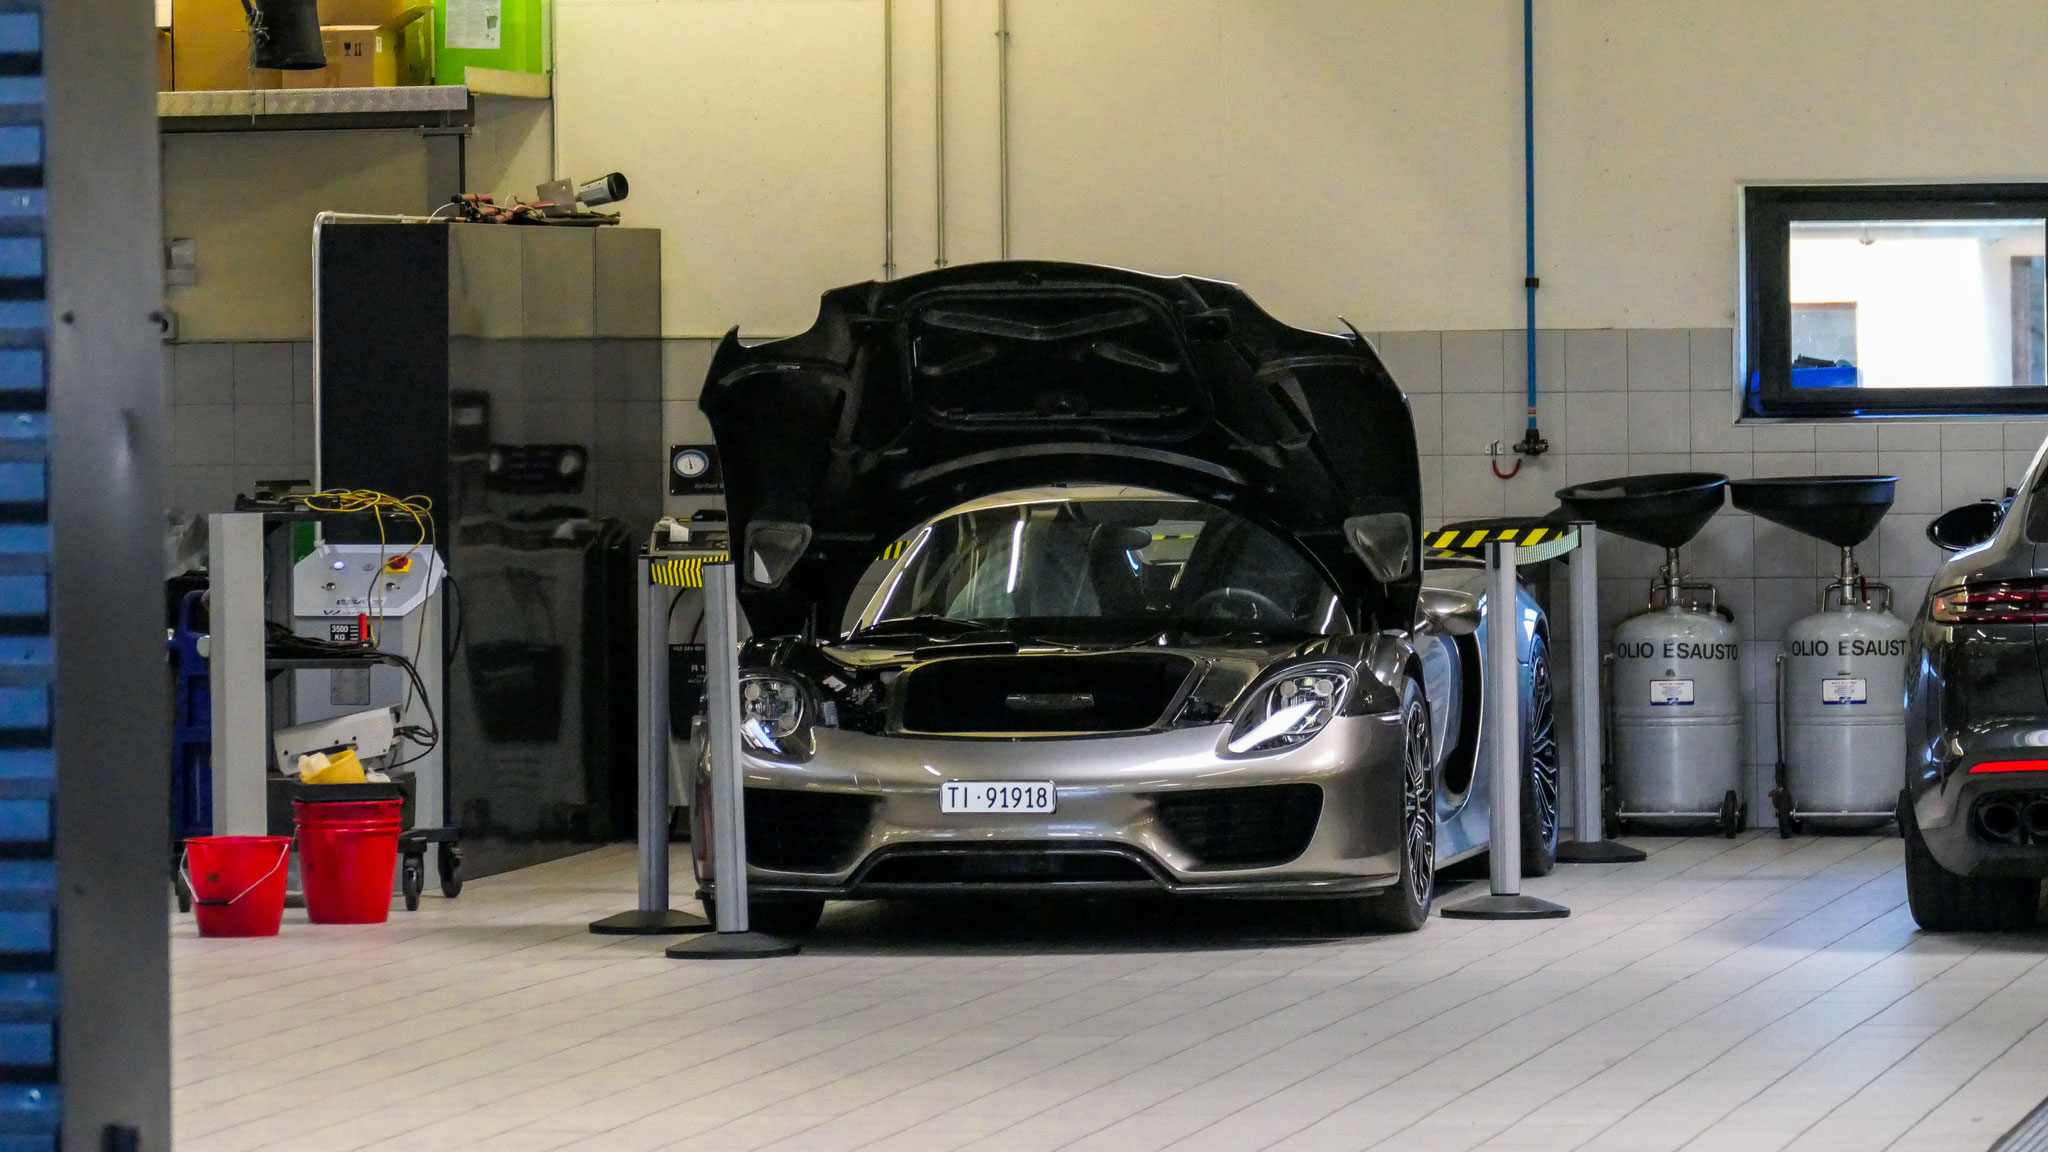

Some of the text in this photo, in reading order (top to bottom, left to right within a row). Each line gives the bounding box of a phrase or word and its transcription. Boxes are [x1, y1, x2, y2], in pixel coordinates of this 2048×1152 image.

[331, 625, 349, 633] 3500
[1618, 642, 1738, 661] OLIO ESAUSTO
[1792, 640, 1907, 657] OLIO ESAUST
